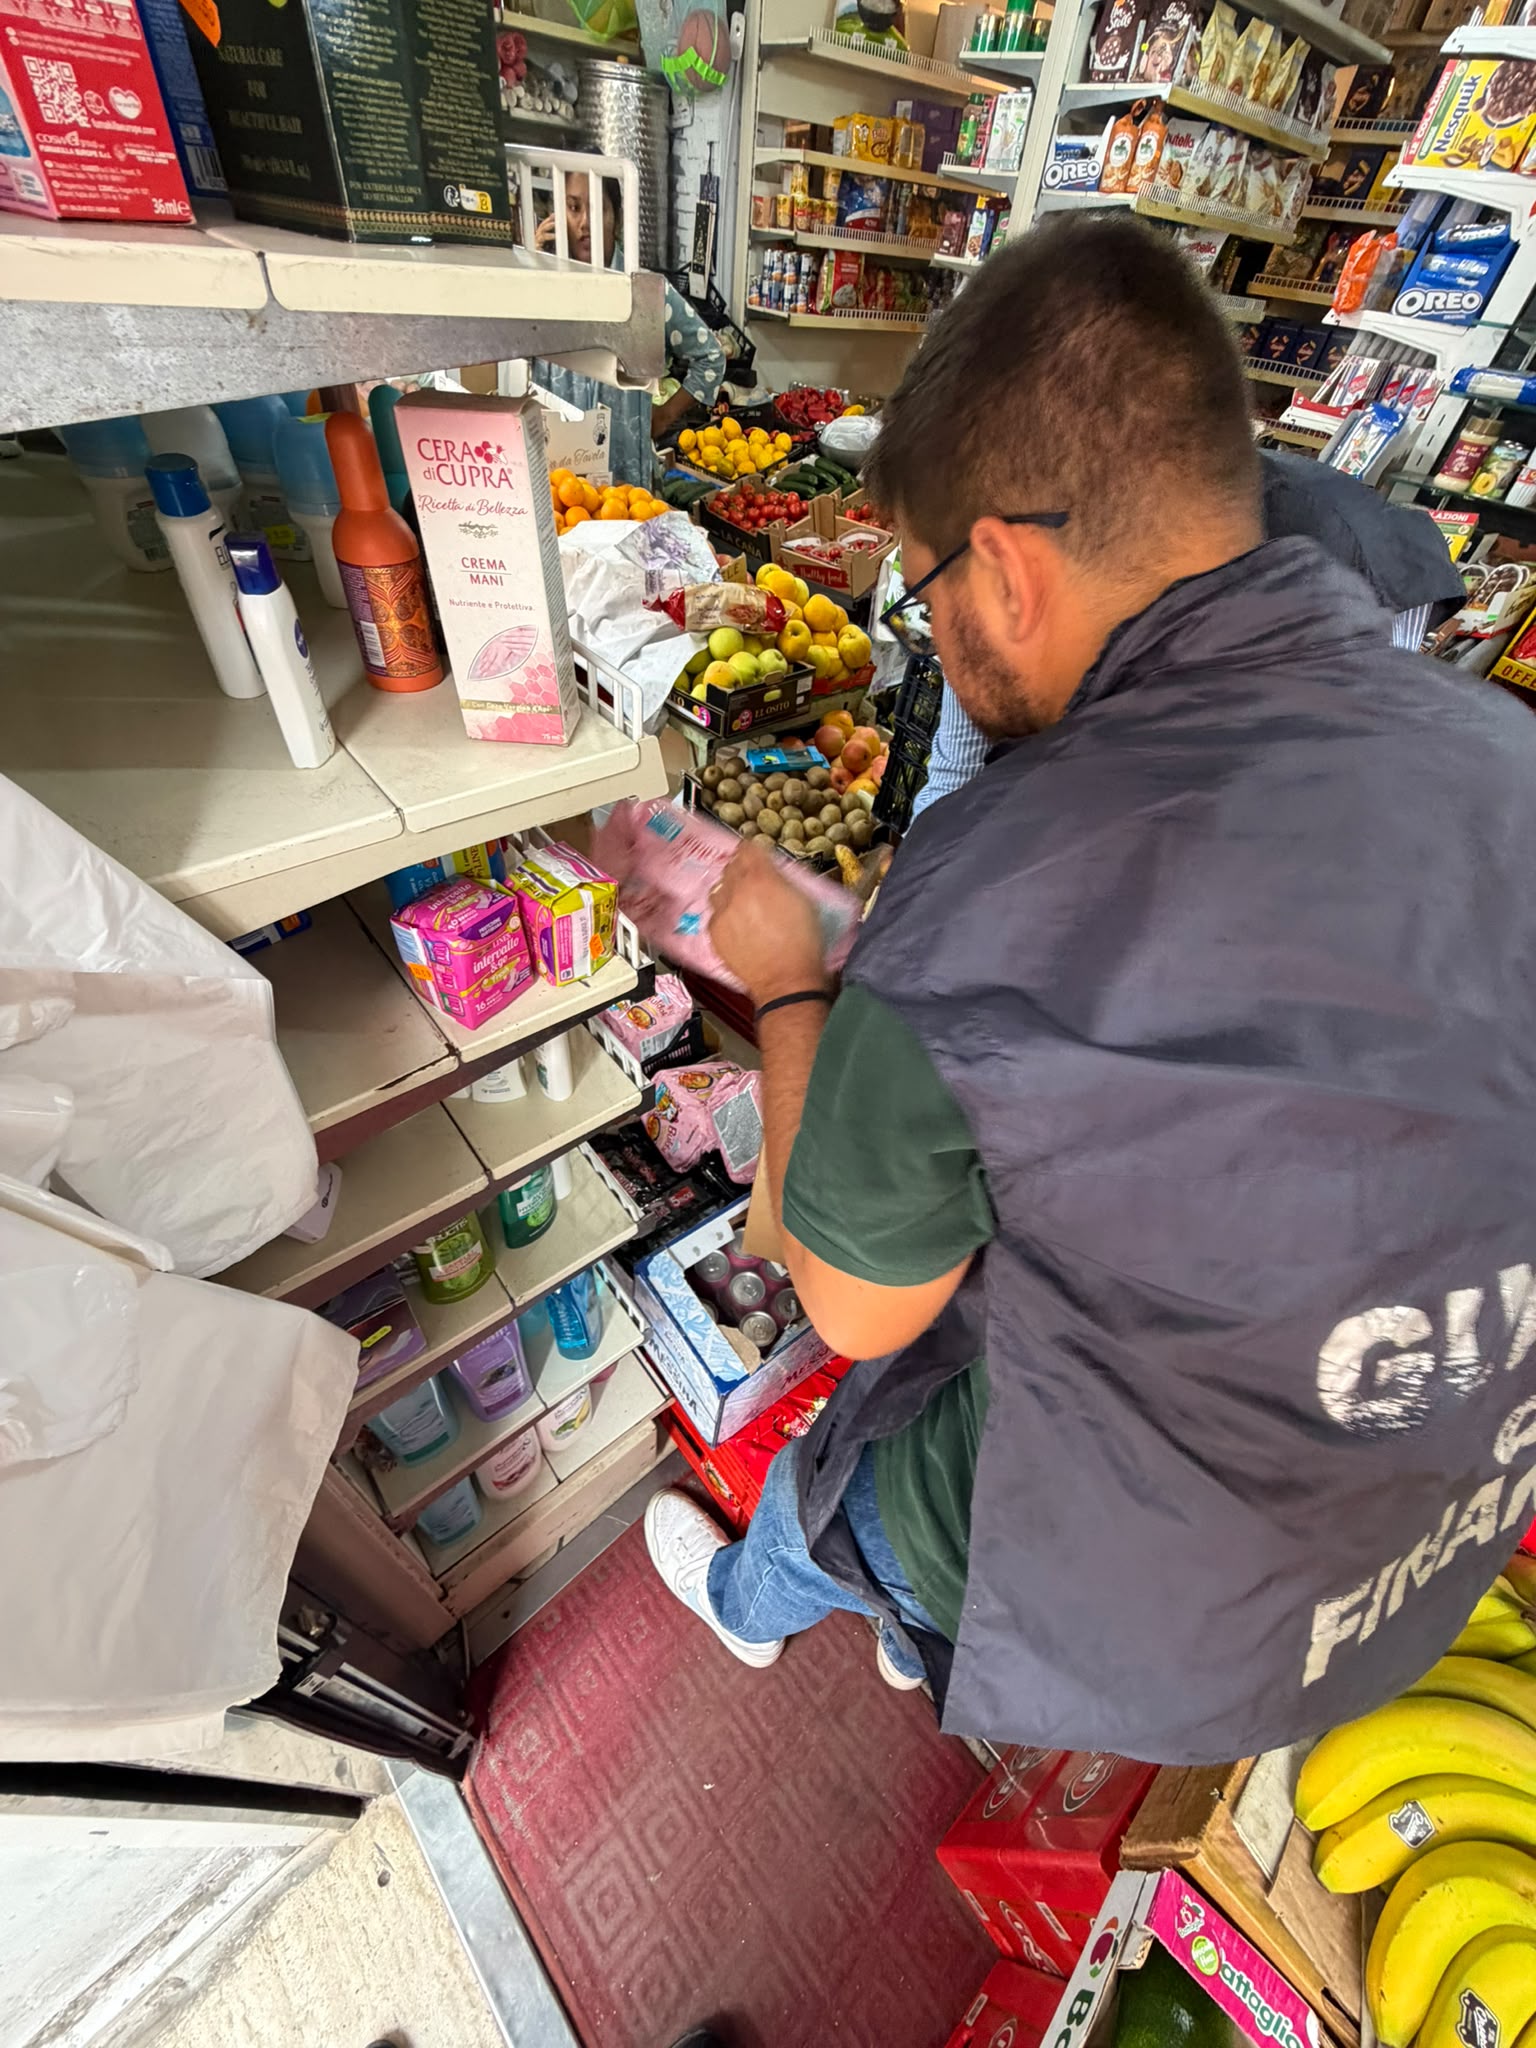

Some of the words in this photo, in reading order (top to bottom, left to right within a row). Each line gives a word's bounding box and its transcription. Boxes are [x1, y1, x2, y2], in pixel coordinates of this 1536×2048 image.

[1432, 75, 1482, 153] Nesquik
[1043, 160, 1101, 188] OREO
[1392, 288, 1483, 318] OREO
[417, 438, 477, 464] CERA
[423, 468, 436, 481] di
[436, 464, 514, 489] CUPRA
[418, 495, 464, 513] Ricetta
[465, 500, 475, 511] di
[476, 499, 529, 516] Bellezza
[461, 557, 507, 571] CREMA
[721, 564, 740, 581] ELE
[470, 574, 504, 586] MANI
[449, 599, 486, 608] Nutriente
[492, 934, 512, 948] LINES
[473, 937, 520, 974] intervallo
[1221, 1961, 1302, 2048] attaglio
